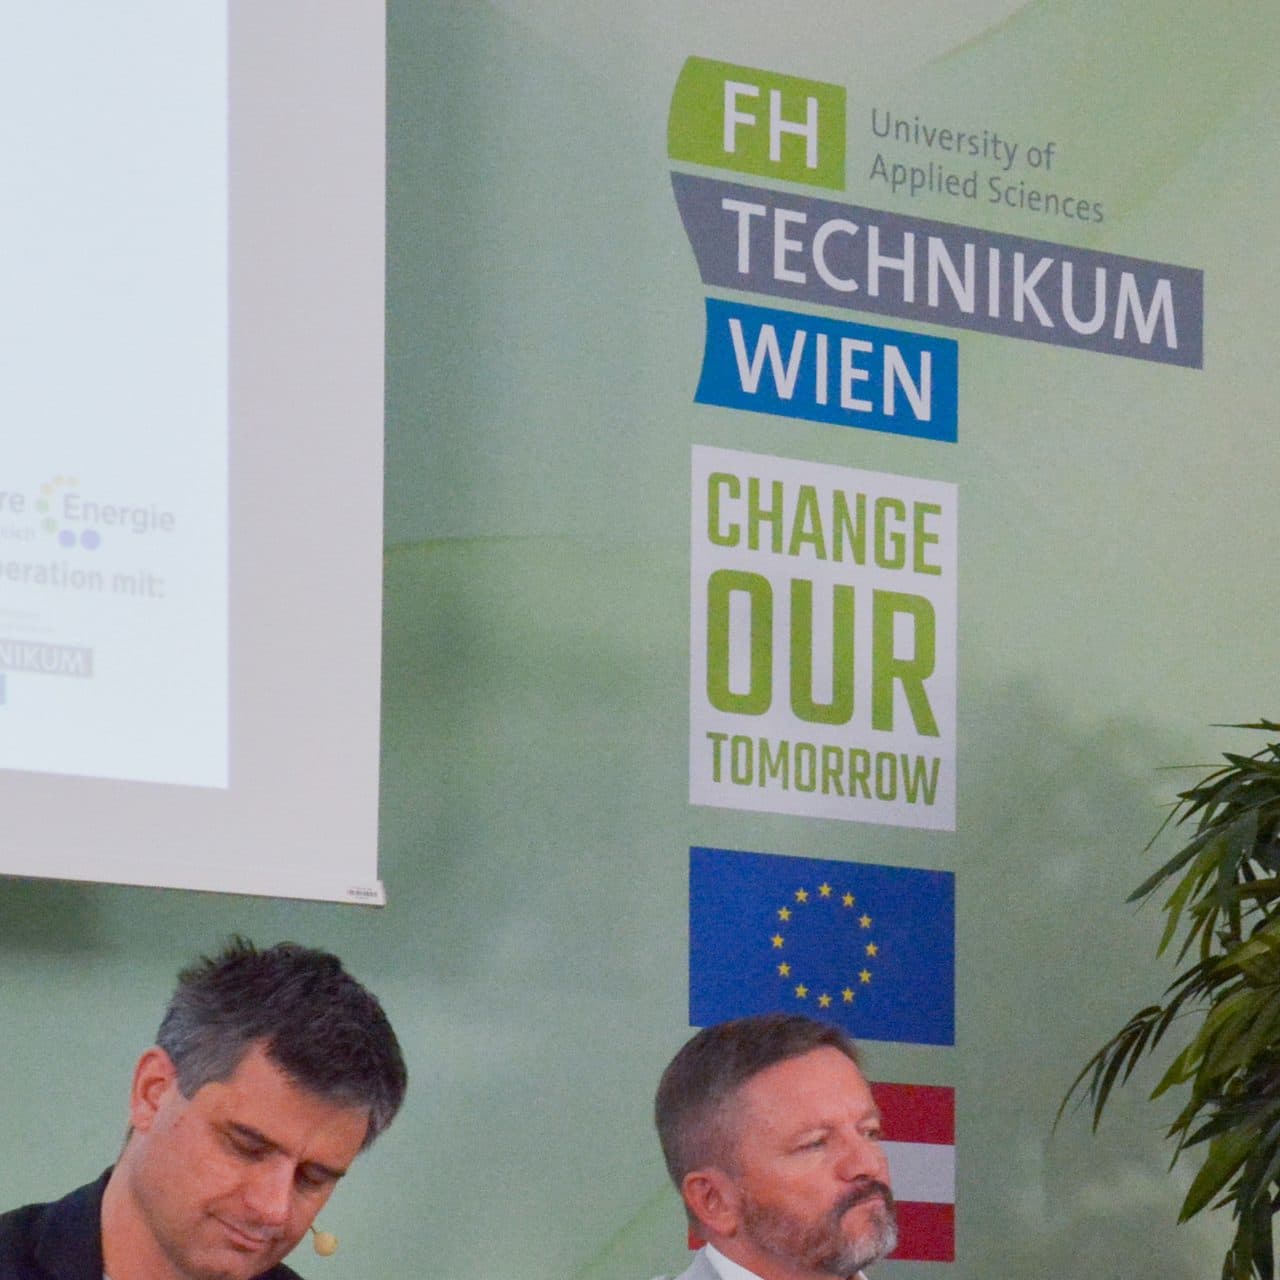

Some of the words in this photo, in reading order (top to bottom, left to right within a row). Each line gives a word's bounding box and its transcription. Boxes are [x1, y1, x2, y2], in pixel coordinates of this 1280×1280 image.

[723, 80, 818, 169] FH
[870, 107, 1019, 167] University
[1026, 141, 1056, 170] of
[869, 153, 979, 202] Applied
[988, 175, 1105, 224] Sciences
[721, 198, 1178, 349] TECHNIKUM
[728, 318, 933, 422] WIEN
[62, 493, 176, 534] Energie
[707, 471, 942, 576] CHANGE
[112, 571, 166, 599] mit:
[706, 569, 941, 738] OUR
[706, 731, 941, 806] TOMORROW
